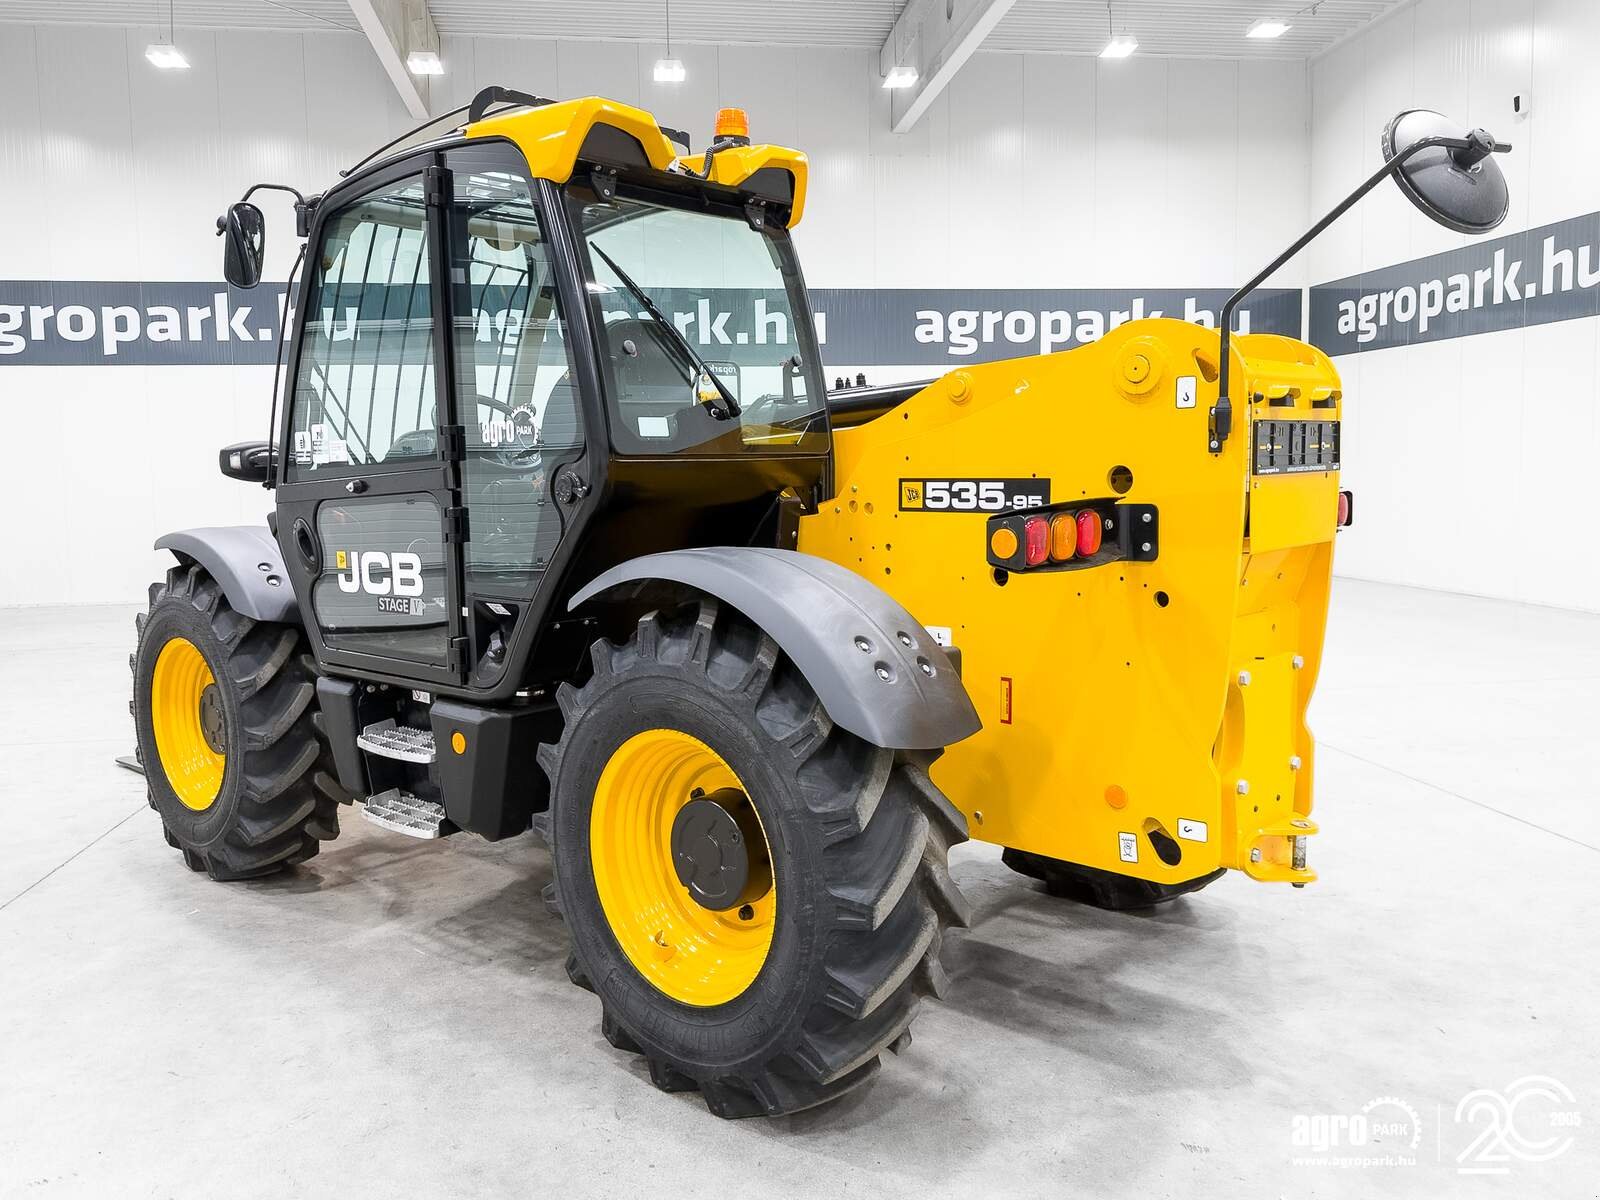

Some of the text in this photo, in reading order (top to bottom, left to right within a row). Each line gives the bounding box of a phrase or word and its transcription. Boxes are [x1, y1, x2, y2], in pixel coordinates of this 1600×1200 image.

[481, 420, 515, 447] agro
[516, 425, 533, 435] PARK
[924, 481, 1043, 510] 535-95
[337, 551, 424, 597] JCB
[378, 597, 409, 613] STAGE
